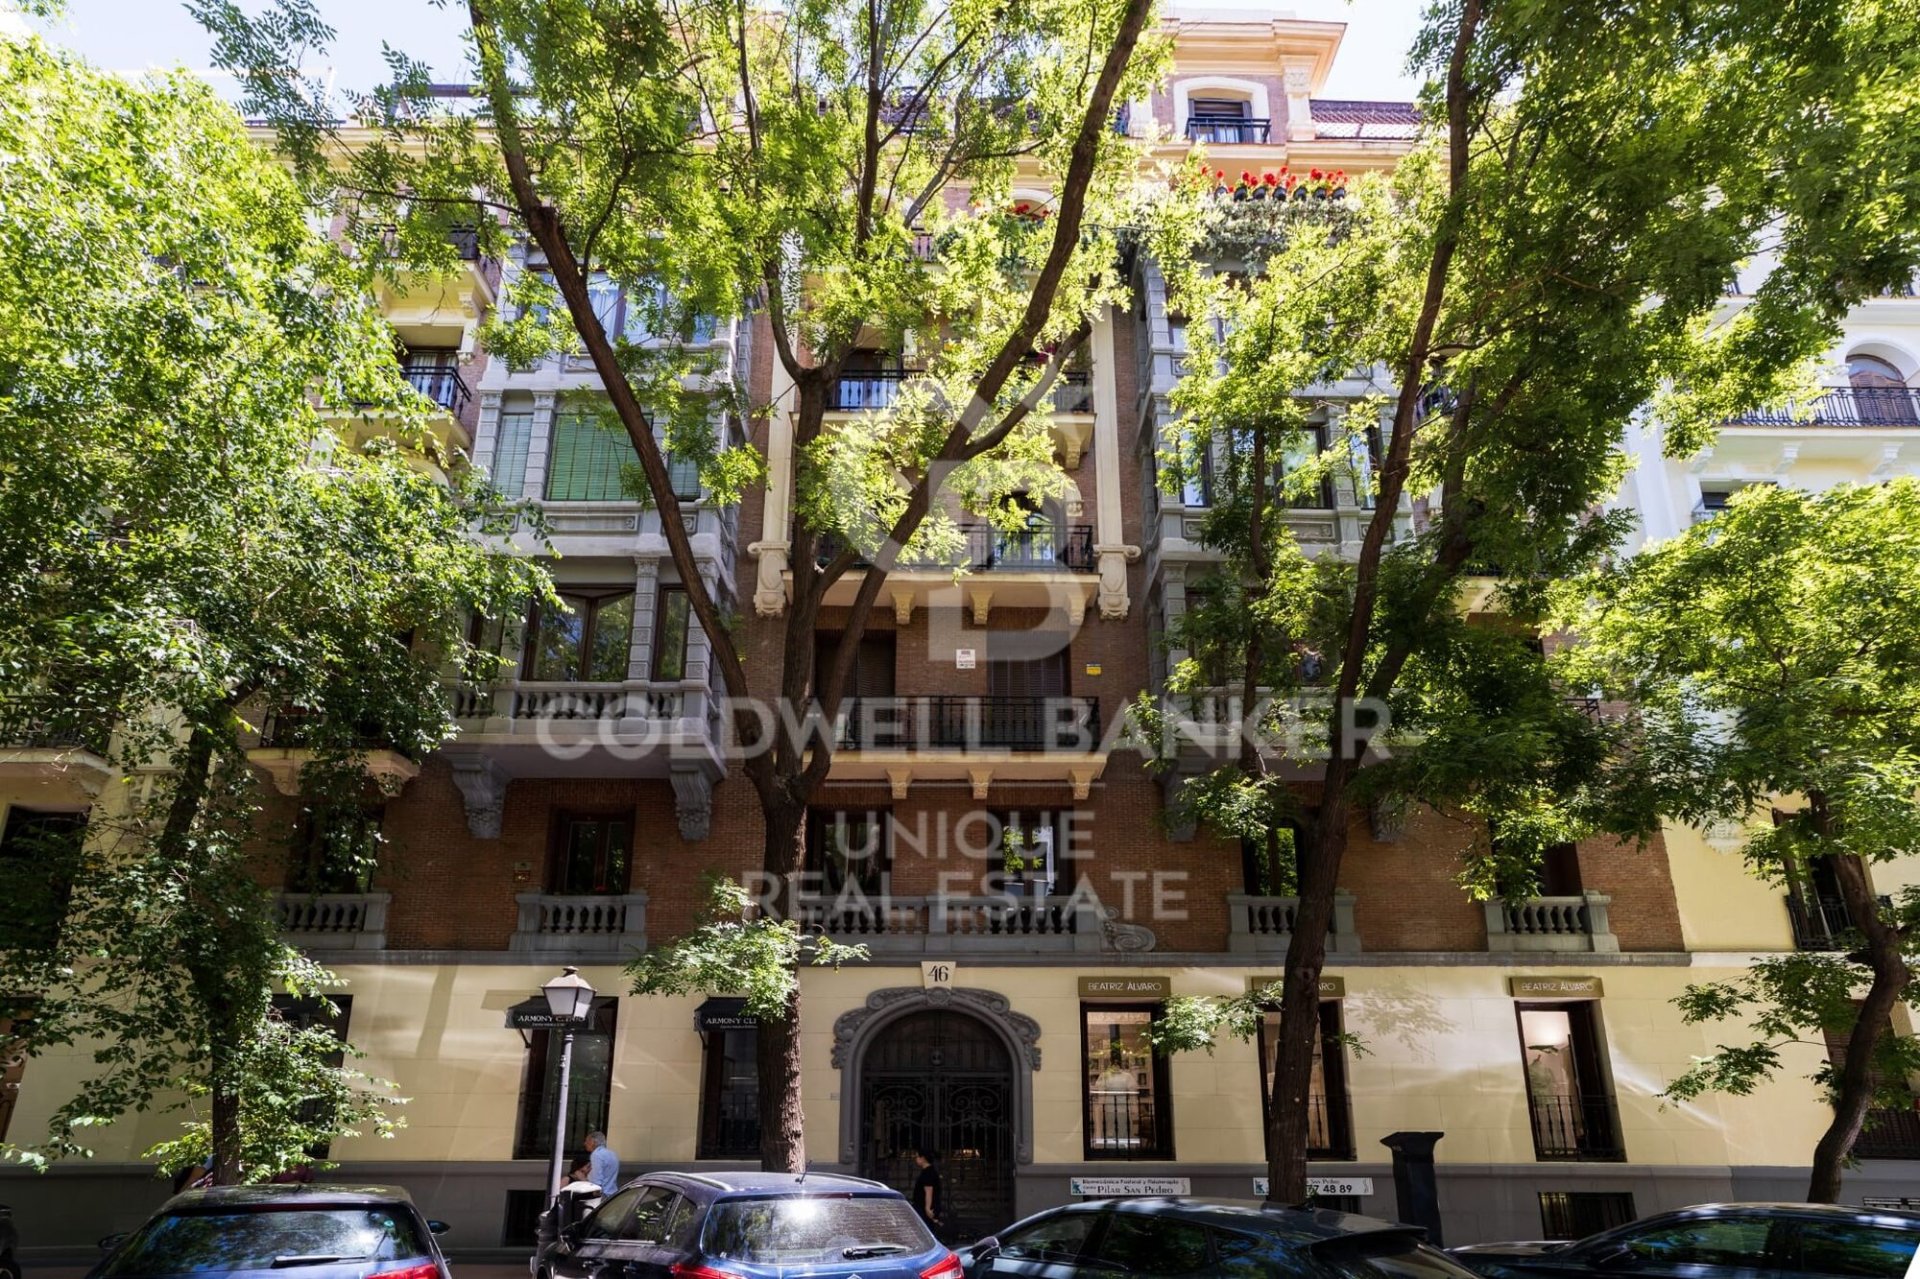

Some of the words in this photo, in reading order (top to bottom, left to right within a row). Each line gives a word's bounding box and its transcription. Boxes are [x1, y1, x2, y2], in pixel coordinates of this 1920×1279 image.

[927, 965, 949, 982] 46
[1088, 983, 1123, 991] BEATRIZ
[1522, 983, 1557, 991] BEATRIZ
[1323, 1185, 1336, 1193] 48
[1339, 1185, 1352, 1193] 89
